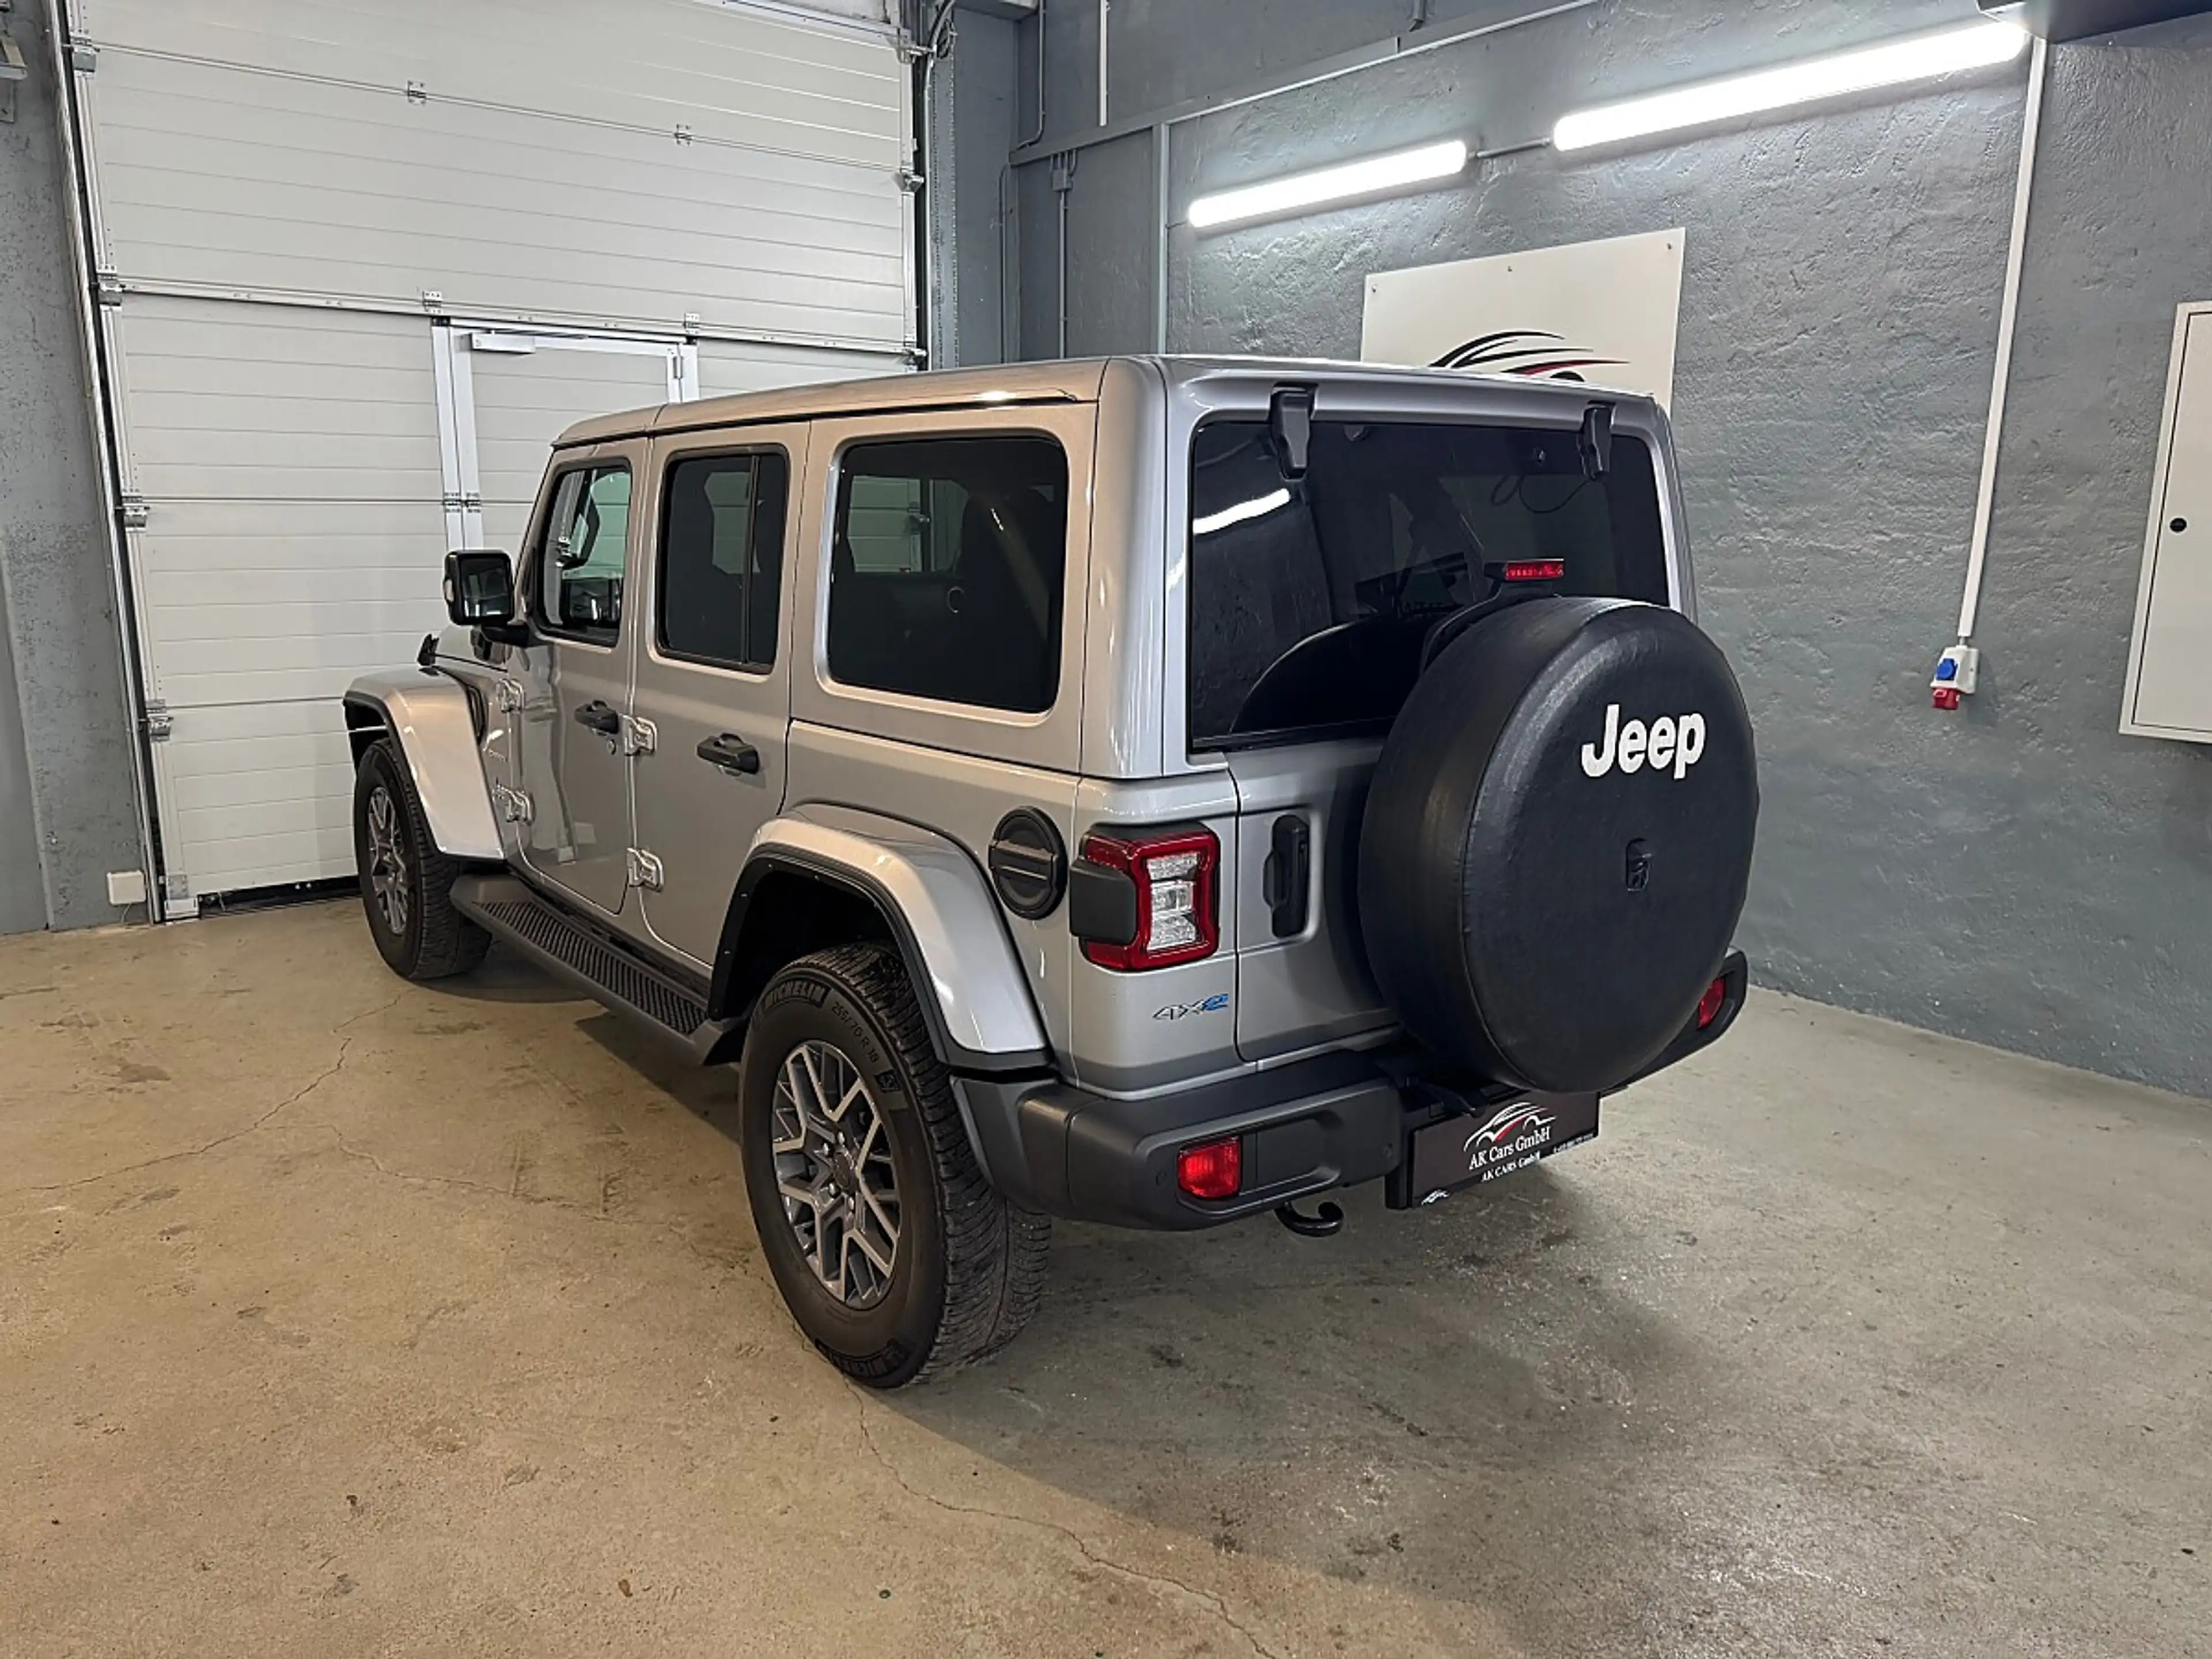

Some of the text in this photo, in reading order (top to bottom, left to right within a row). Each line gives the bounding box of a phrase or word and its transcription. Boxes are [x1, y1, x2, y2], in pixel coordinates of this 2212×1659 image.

[1581, 703, 1706, 779] Jeep
[1469, 1151, 1487, 1169] AK
[1489, 1144, 1514, 1161] Cars
[1516, 1126, 1551, 1151] GmbH
